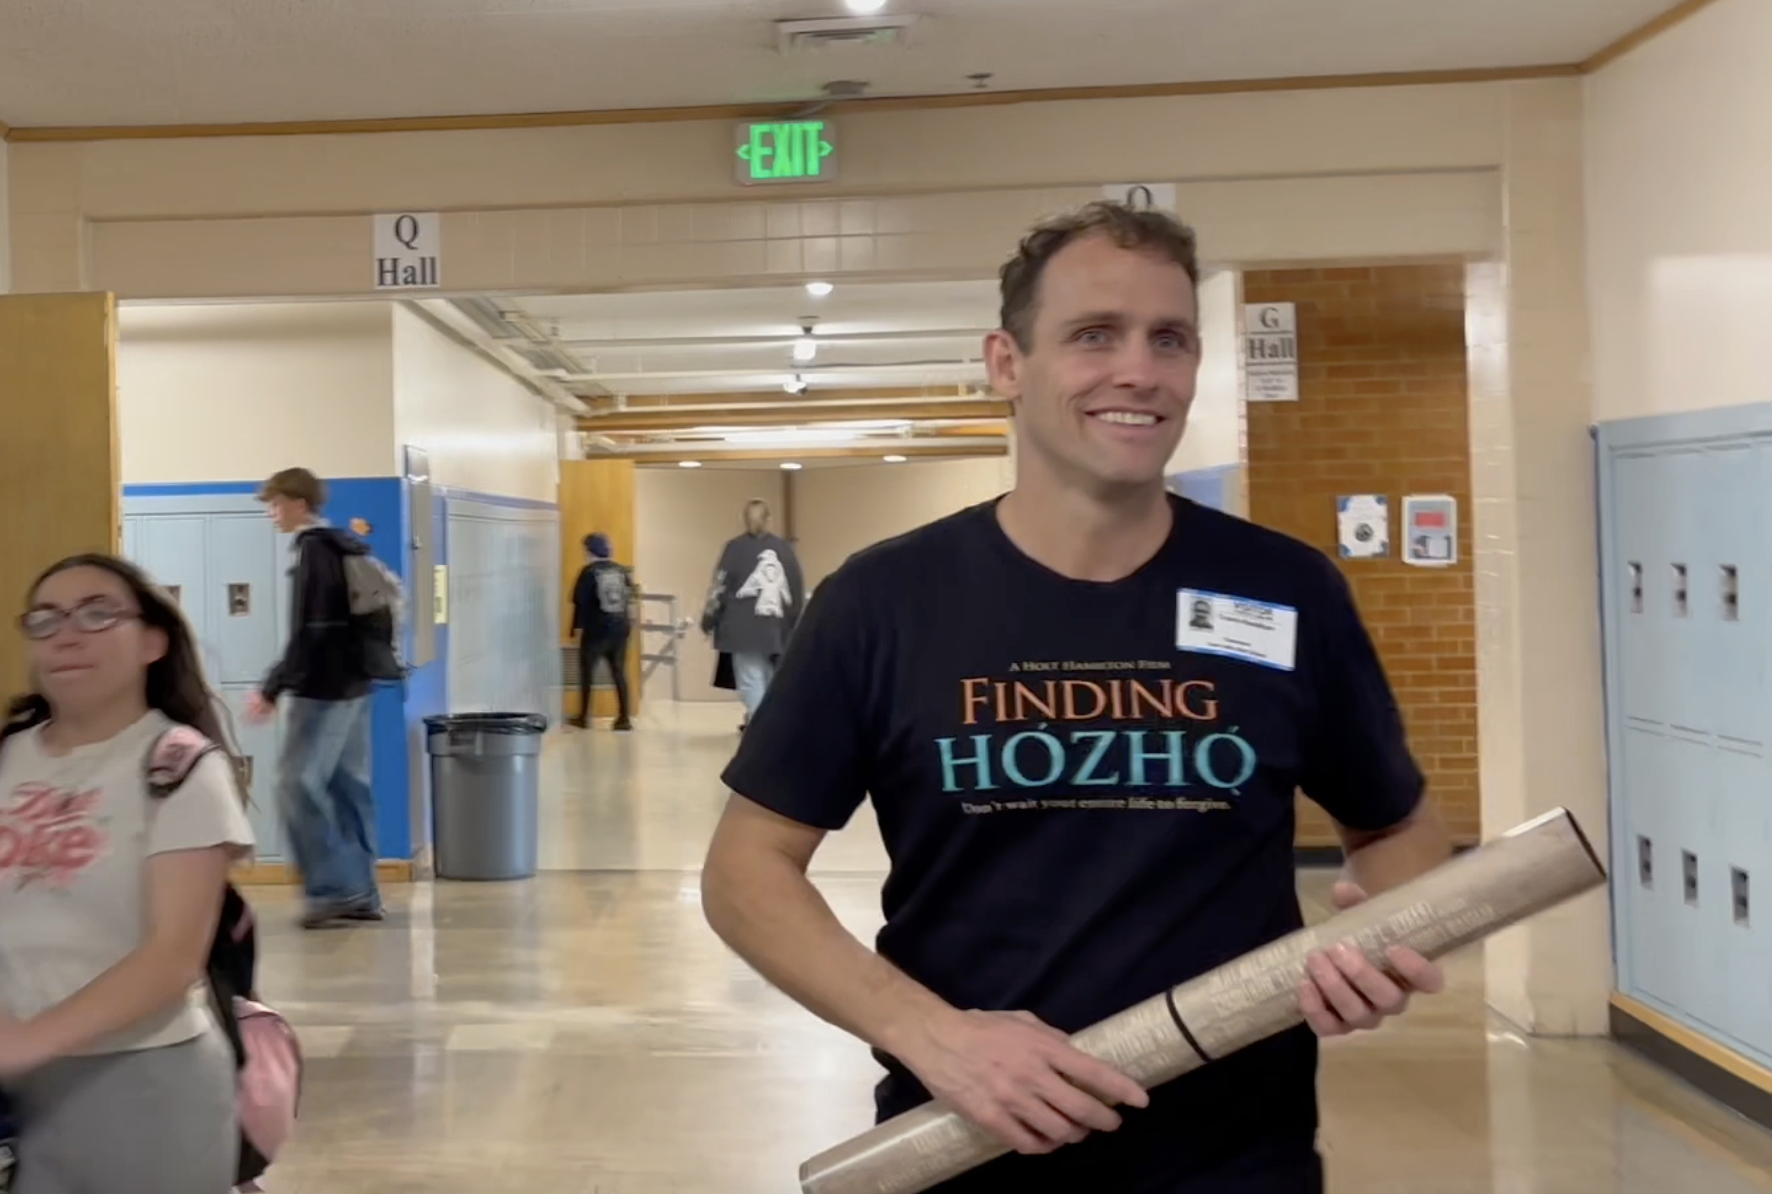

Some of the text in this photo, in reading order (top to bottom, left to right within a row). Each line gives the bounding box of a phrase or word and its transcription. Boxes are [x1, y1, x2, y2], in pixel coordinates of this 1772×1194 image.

[750, 122, 823, 178] EXIT
[394, 214, 419, 250] Q
[377, 256, 438, 286] Hall
[1259, 307, 1279, 329] G
[1248, 337, 1294, 359] Hall
[959, 677, 1219, 725] FINDING
